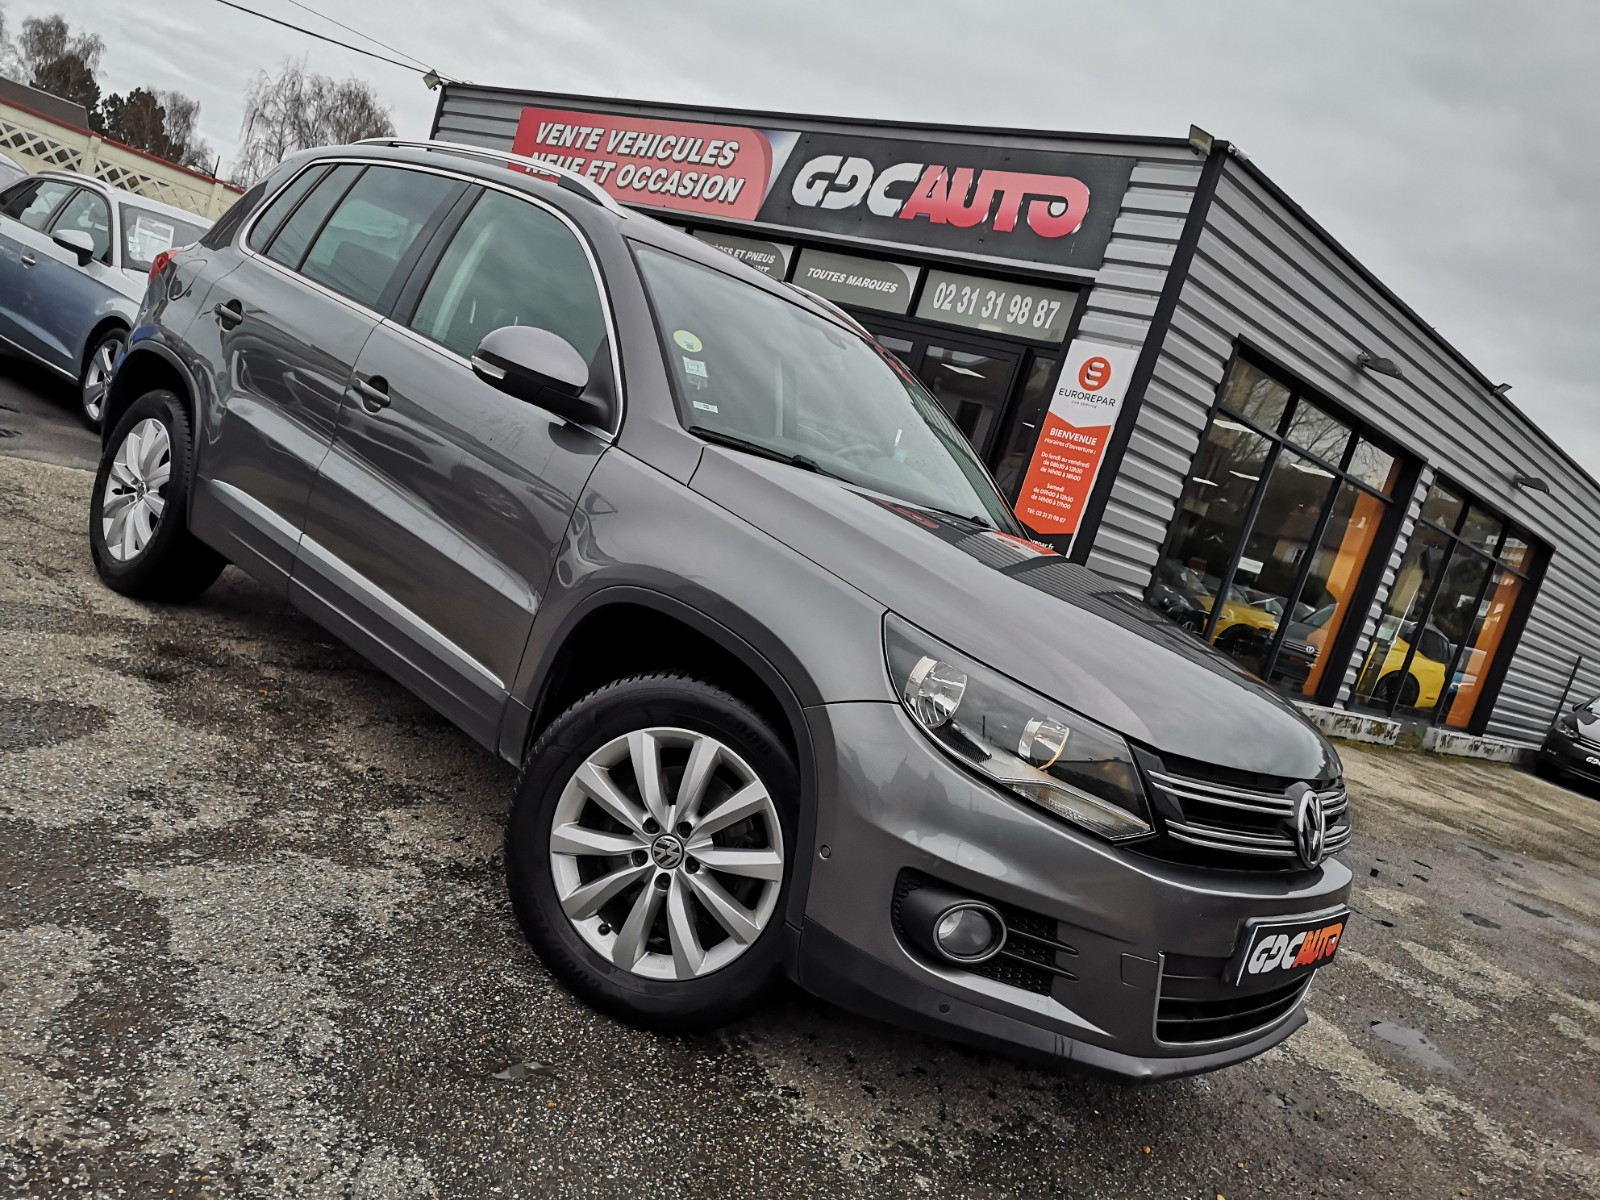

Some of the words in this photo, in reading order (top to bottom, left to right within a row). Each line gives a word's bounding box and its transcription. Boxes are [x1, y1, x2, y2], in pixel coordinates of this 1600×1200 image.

[535, 121, 605, 151] VENTE
[606, 129, 740, 168] VEHICULES
[586, 160, 617, 184] ET
[616, 164, 745, 204] OCCASION
[734, 248, 747, 258] ET
[745, 251, 776, 264] PNEUS
[806, 267, 847, 284] TOUTES
[846, 274, 899, 294] MARQUES
[933, 281, 957, 311] 02
[956, 286, 980, 315] 31
[982, 290, 1006, 320] 31
[1006, 294, 1033, 325] 98
[1032, 298, 1062, 329] 87
[1058, 387, 1116, 408] EUROREPAR
[1044, 438, 1065, 447] Horaires
[1050, 427, 1098, 446] BIENVENUE
[1048, 453, 1061, 461] lundi
[1068, 459, 1090, 468] vendredi
[1047, 483, 1064, 492] Samedi
[1248, 922, 1344, 974] GDCAUTO
